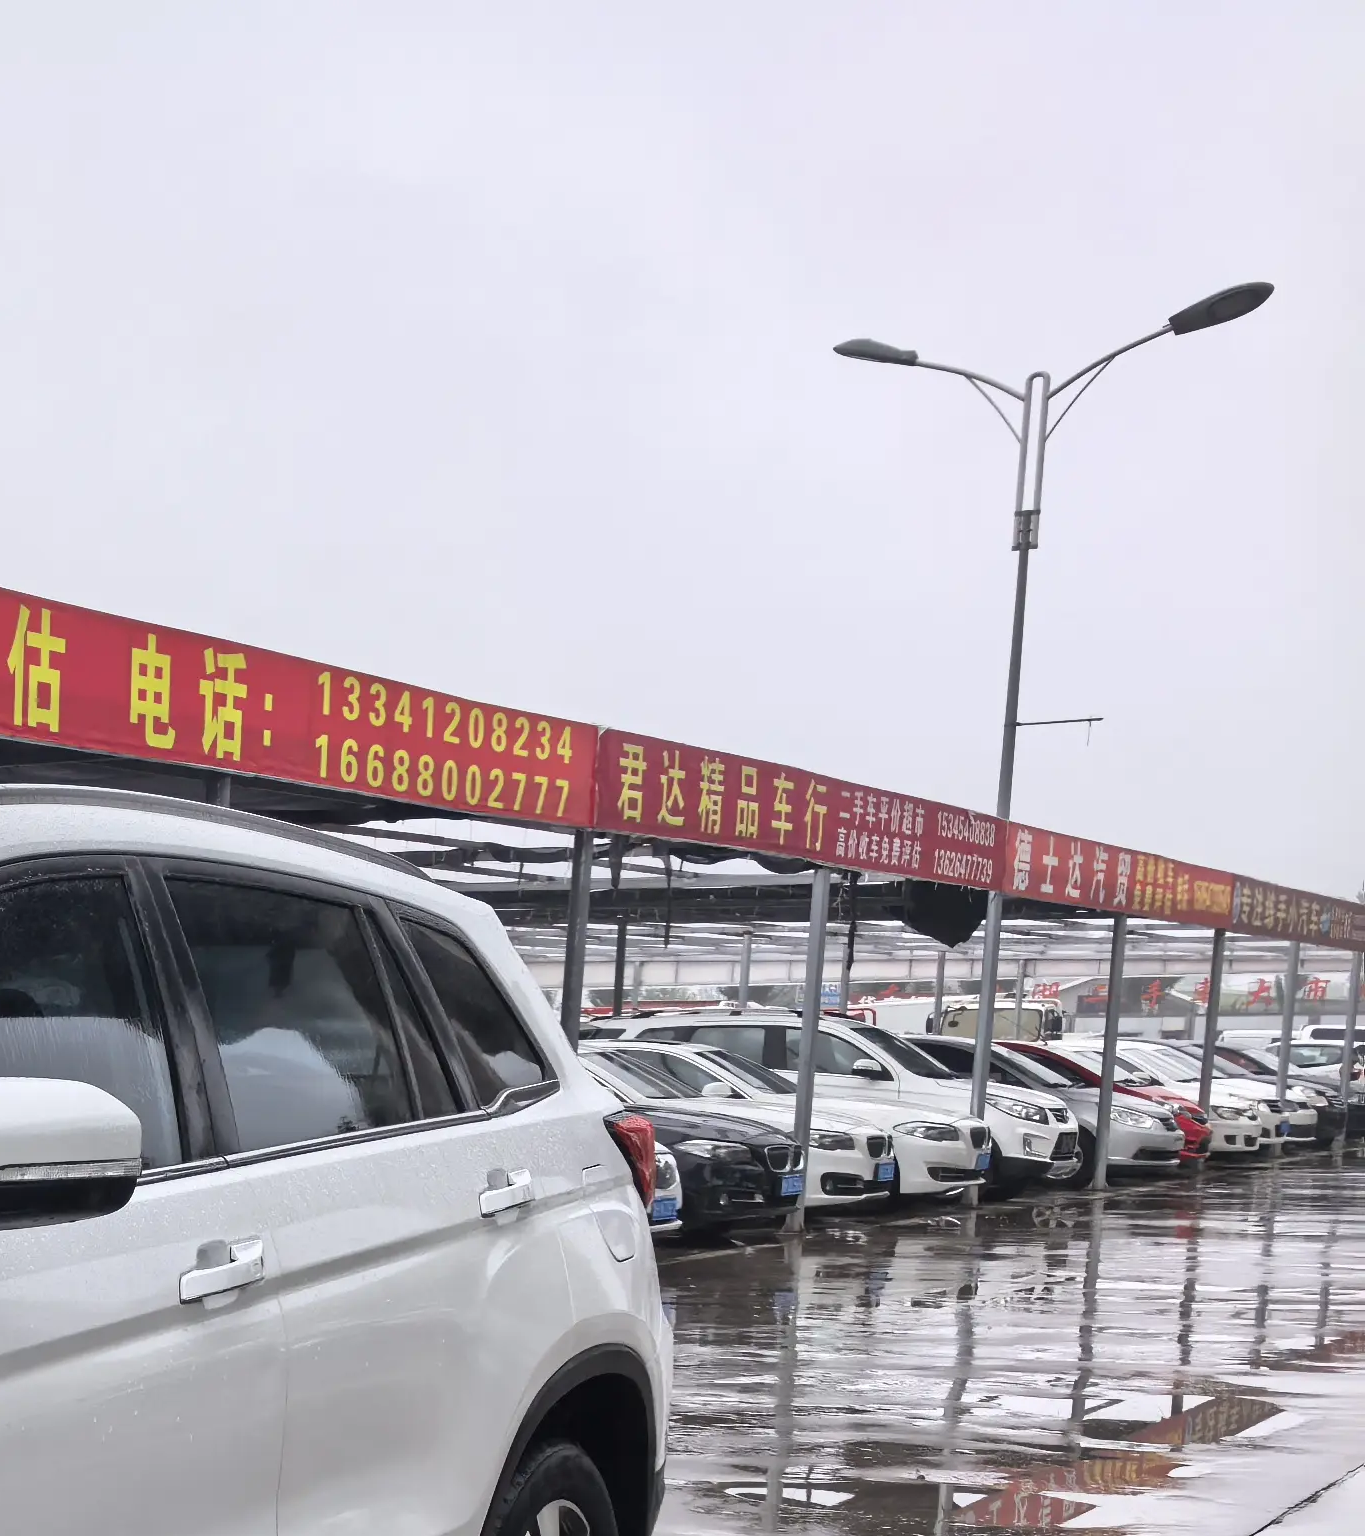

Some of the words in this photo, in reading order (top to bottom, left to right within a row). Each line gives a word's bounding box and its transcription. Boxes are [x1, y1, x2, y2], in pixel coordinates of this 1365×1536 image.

[130, 633, 273, 762] 电话：
[317, 671, 573, 764] 13341208234
[315, 734, 570, 818] 16688002777
[618, 742, 828, 851] 君达精品车行
[835, 827, 922, 869] 高价收车免费评估
[933, 848, 993, 883] 13626477739
[839, 791, 925, 838] 二手车平价超市
[937, 811, 996, 847] 15345408838
[1012, 828, 1131, 907] 德士达汽贸
